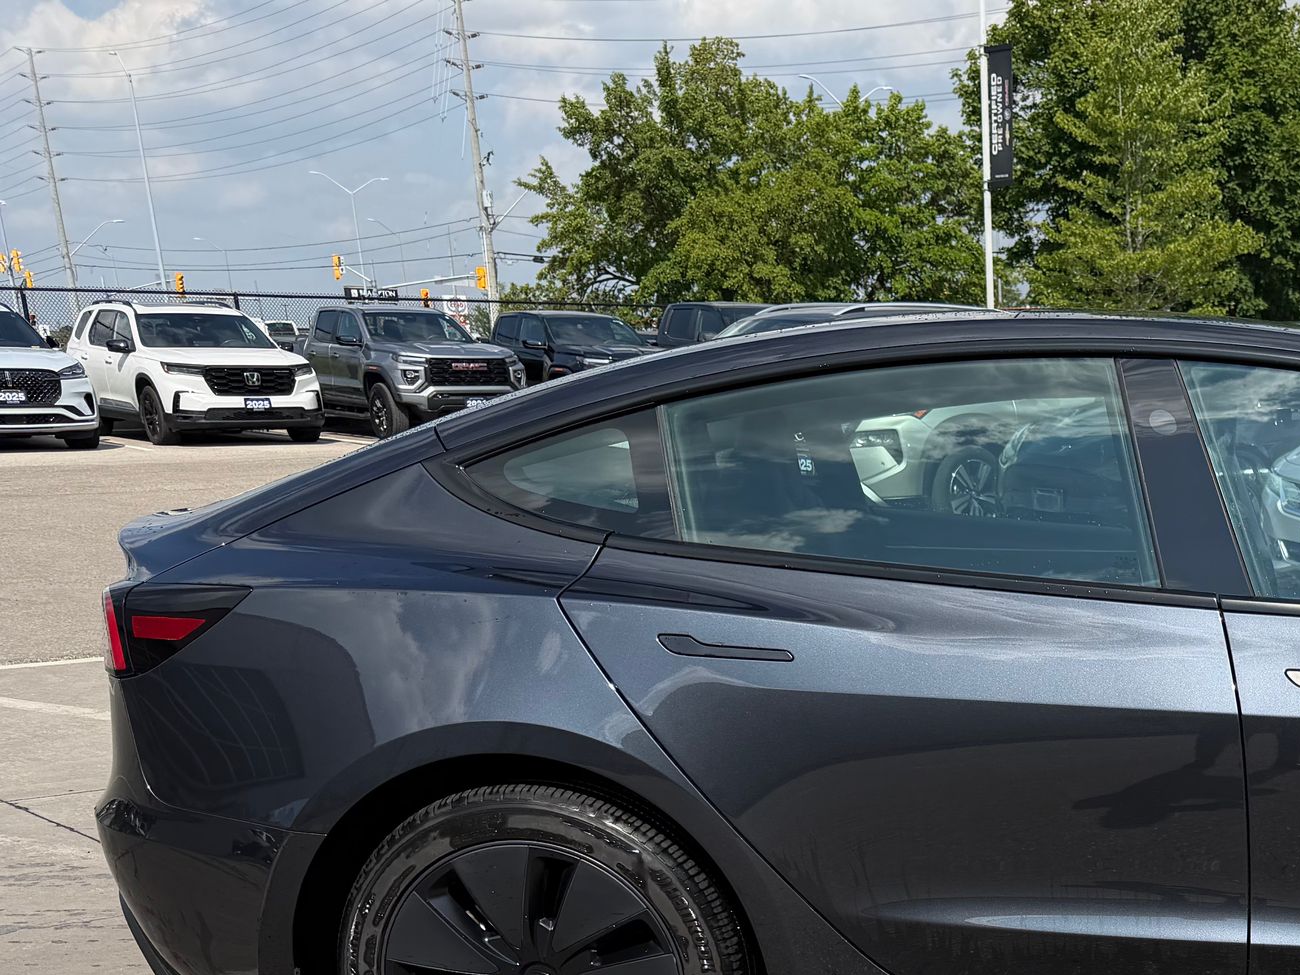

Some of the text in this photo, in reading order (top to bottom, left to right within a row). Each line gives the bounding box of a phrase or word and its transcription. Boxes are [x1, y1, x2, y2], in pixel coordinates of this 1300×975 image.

[990, 73, 998, 155] CERTIFIED
[0, 392, 26, 401] 2025
[246, 400, 271, 409] 2025
